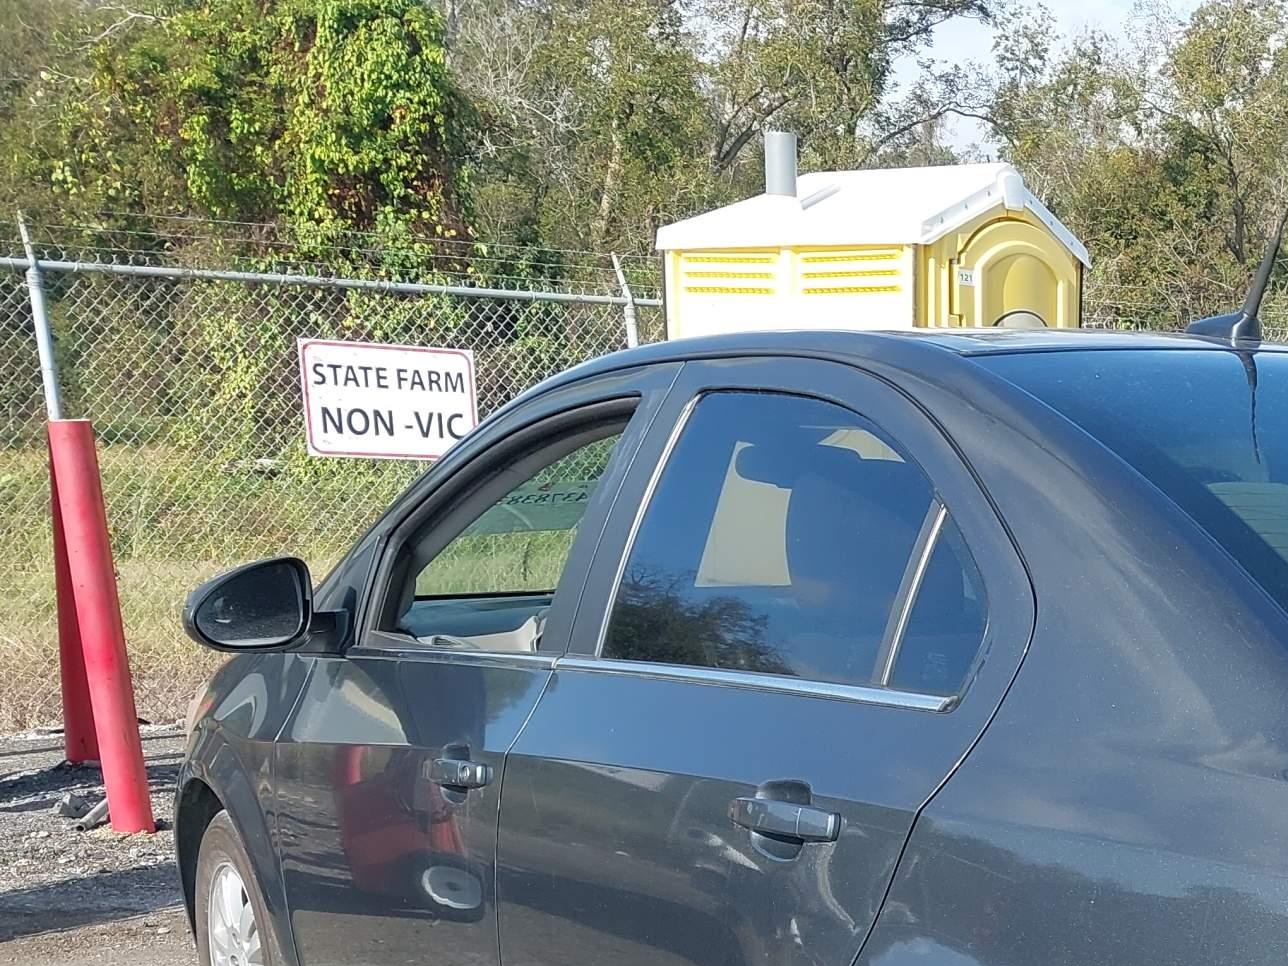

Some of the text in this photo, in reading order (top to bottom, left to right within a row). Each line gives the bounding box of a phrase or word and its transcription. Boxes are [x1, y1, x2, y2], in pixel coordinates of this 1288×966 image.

[312, 363, 465, 393] STATE FARM
[320, 406, 394, 436] NON
